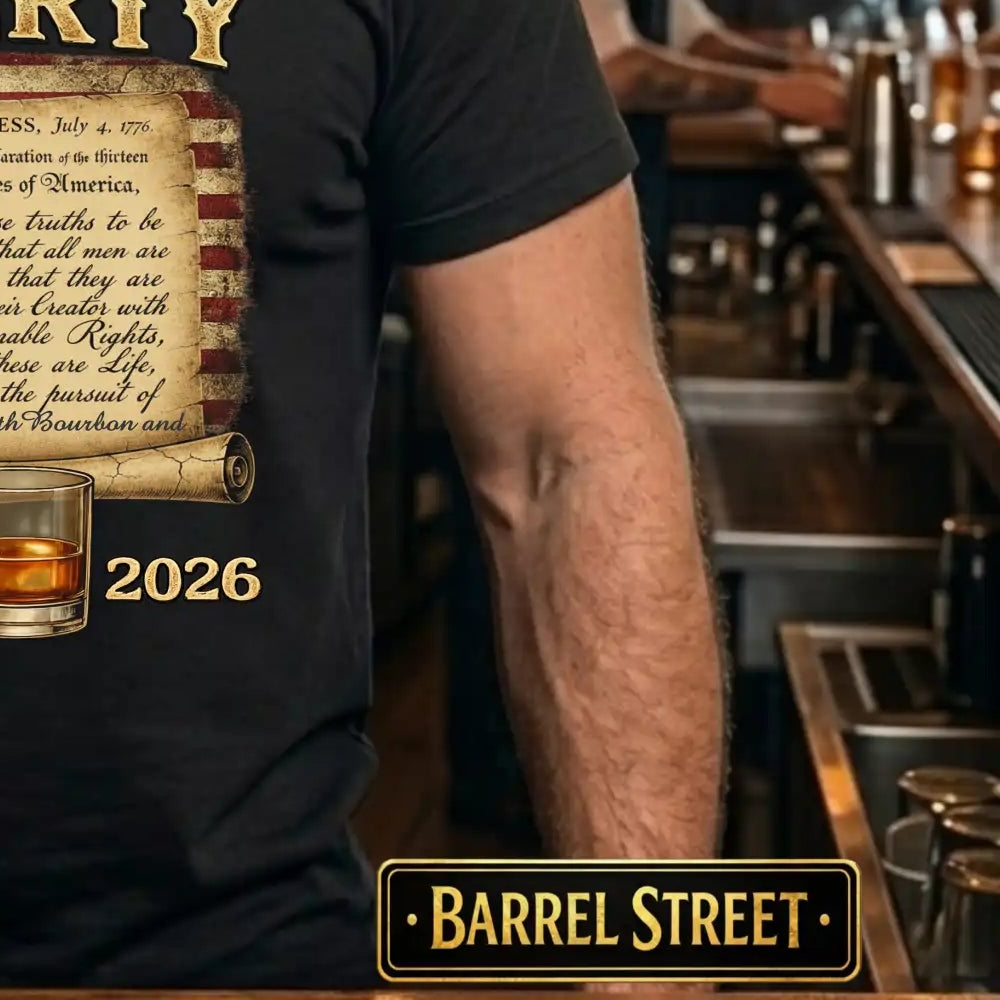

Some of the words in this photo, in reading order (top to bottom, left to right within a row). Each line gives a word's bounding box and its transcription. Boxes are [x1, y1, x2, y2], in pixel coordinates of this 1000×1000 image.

[51, 116, 87, 136] July
[97, 121, 111, 135] 4,
[120, 120, 154, 135] 1776.
[59, 152, 70, 165] of
[73, 152, 89, 164] the
[94, 148, 148, 164] thirteen
[19, 174, 37, 199] of
[40, 173, 140, 195] America,
[25, 209, 94, 232] truths
[107, 212, 130, 231] to
[139, 208, 165, 231] be
[43, 236, 78, 260] all
[82, 246, 129, 260] men
[135, 246, 171, 260] are
[7, 266, 60, 289] that
[64, 266, 117, 300] they
[126, 275, 165, 289] are
[30, 291, 112, 317] Creator
[117, 294, 169, 317] with
[66, 318, 165, 355] Rights,
[51, 360, 89, 374] are
[98, 348, 156, 384] Life,
[0, 379, 37, 403] the
[41, 380, 130, 414] pursuit
[137, 379, 166, 413] of
[20, 410, 139, 433] Bourbon
[143, 411, 186, 432] and
[105, 556, 261, 602] 2026
